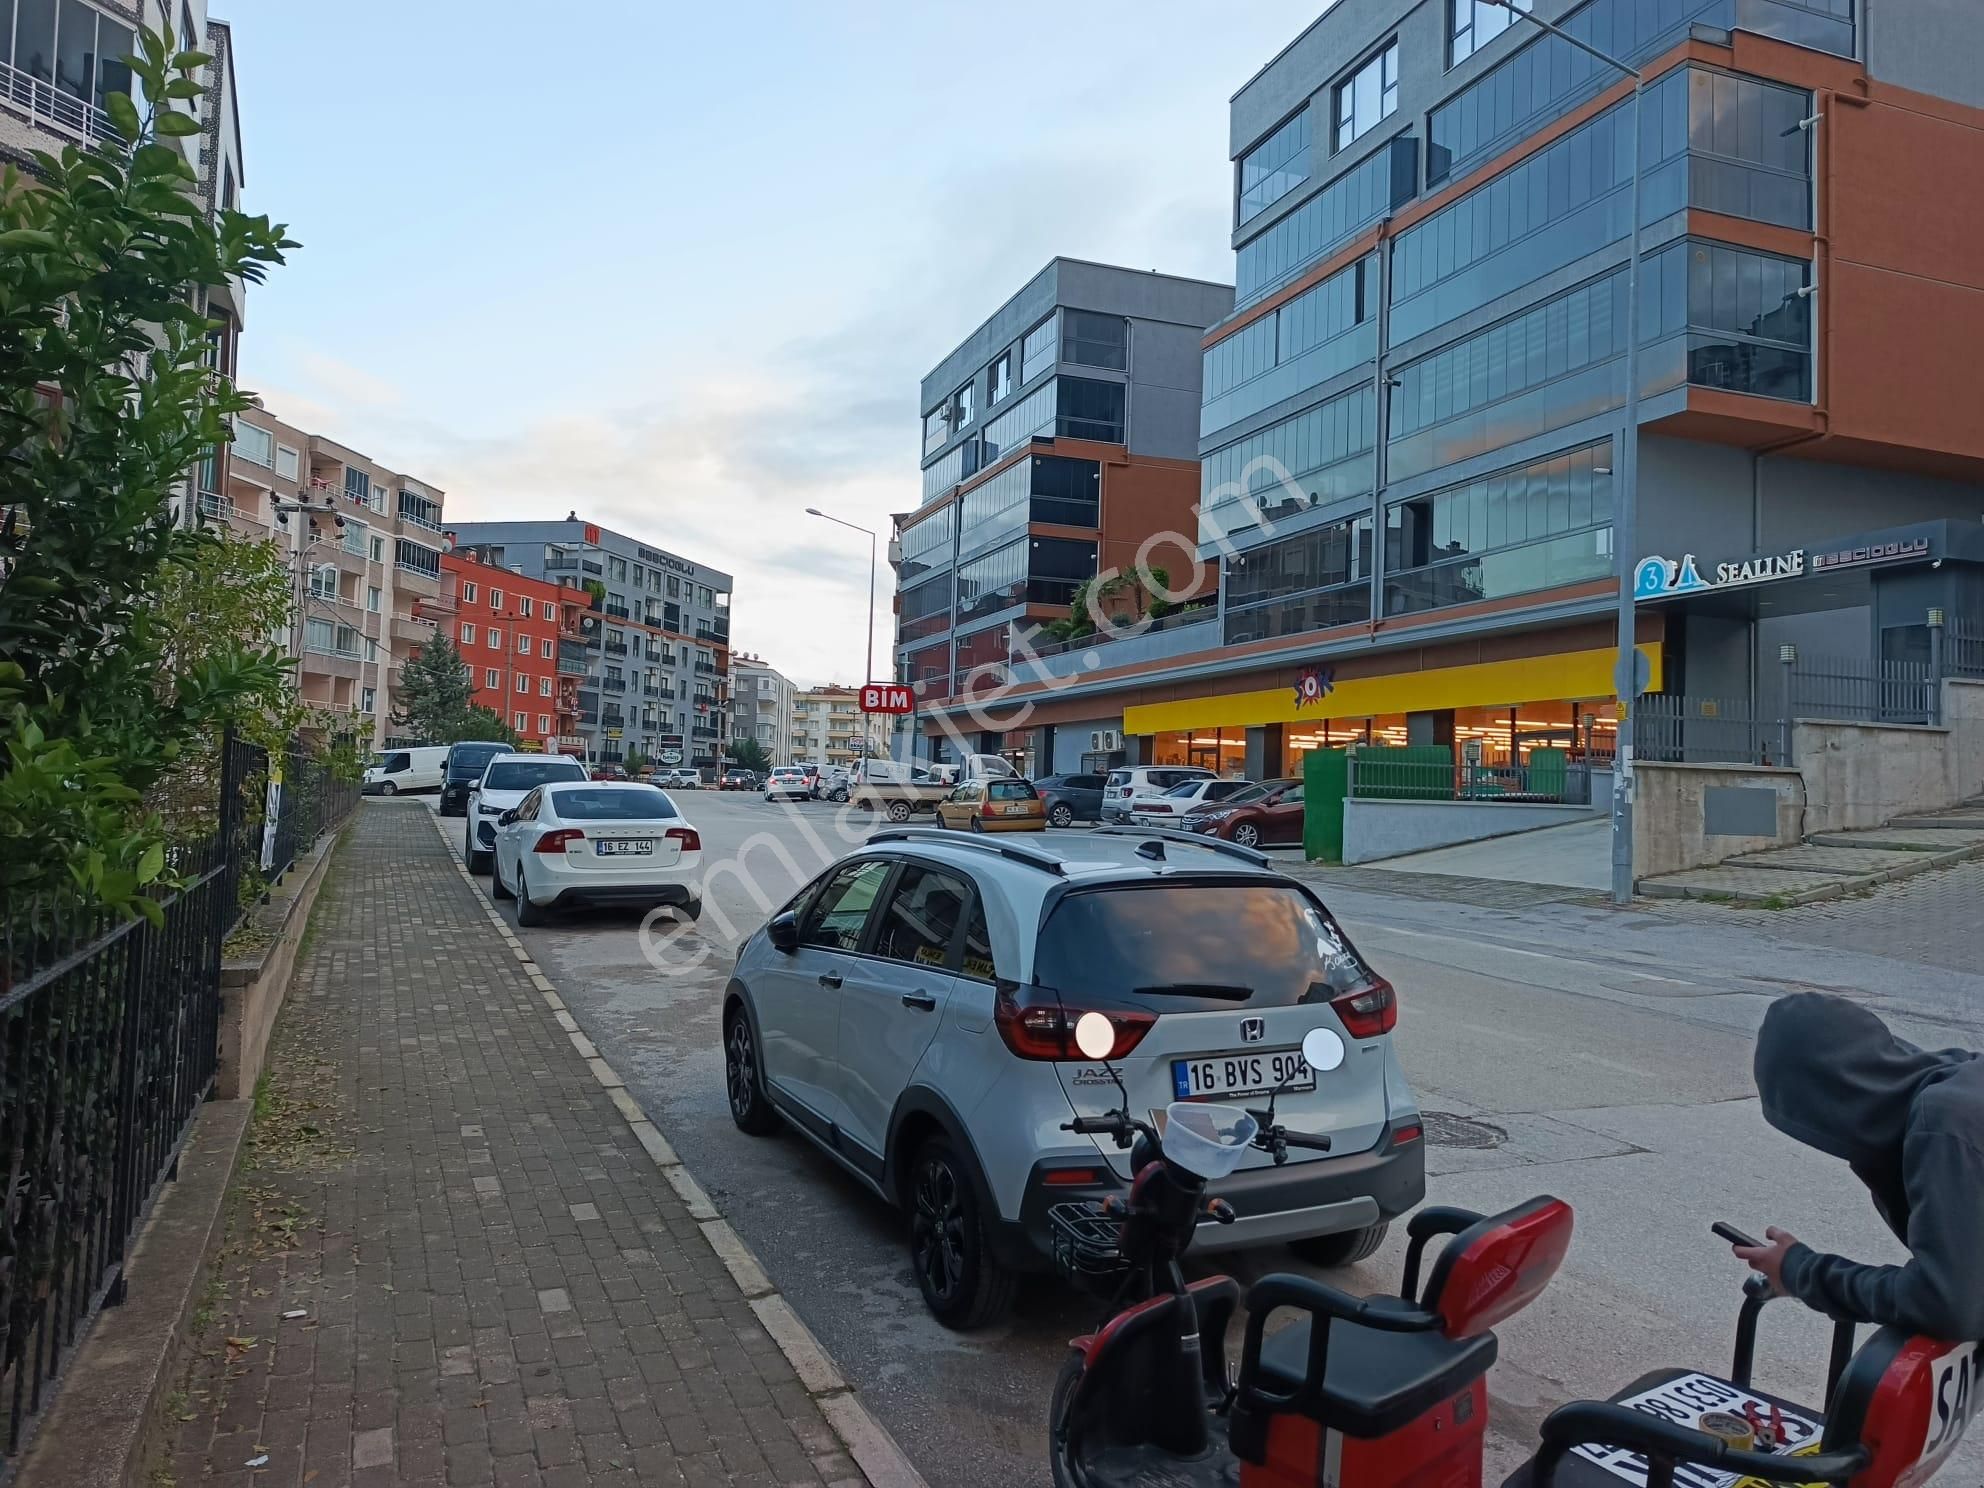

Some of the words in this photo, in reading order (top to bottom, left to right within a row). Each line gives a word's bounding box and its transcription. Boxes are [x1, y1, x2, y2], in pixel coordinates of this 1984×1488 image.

[1716, 549, 1803, 584] SEALINE
[865, 686, 908, 708] BİM
[604, 843, 613, 851] 16
[618, 843, 629, 851] EZ
[635, 842, 650, 851] 144
[1072, 1067, 1124, 1079] JAZZ
[1191, 1063, 1215, 1091] 16
[1225, 1059, 1262, 1087] BVS
[1272, 1055, 1308, 1082] 904
